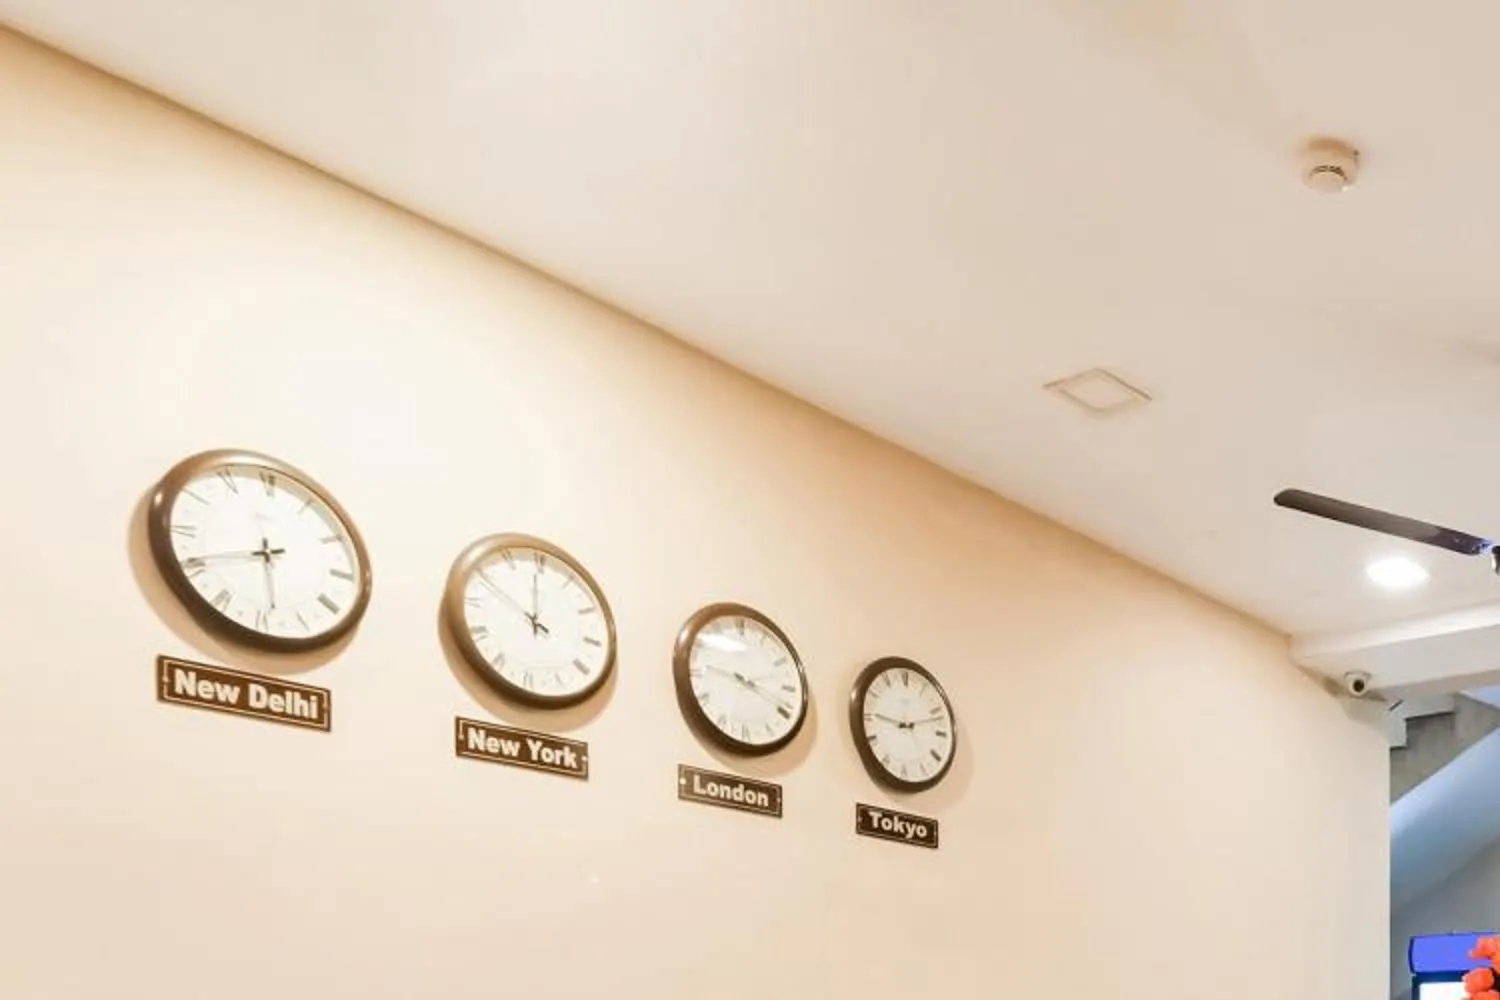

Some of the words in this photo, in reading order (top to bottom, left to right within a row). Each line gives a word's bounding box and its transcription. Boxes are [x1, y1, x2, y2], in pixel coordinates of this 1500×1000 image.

[174, 668, 240, 704] New
[248, 683, 319, 719] Delhi
[467, 727, 521, 757] New
[525, 737, 578, 769] York
[693, 775, 769, 808] London
[868, 811, 928, 838] Tokyo
